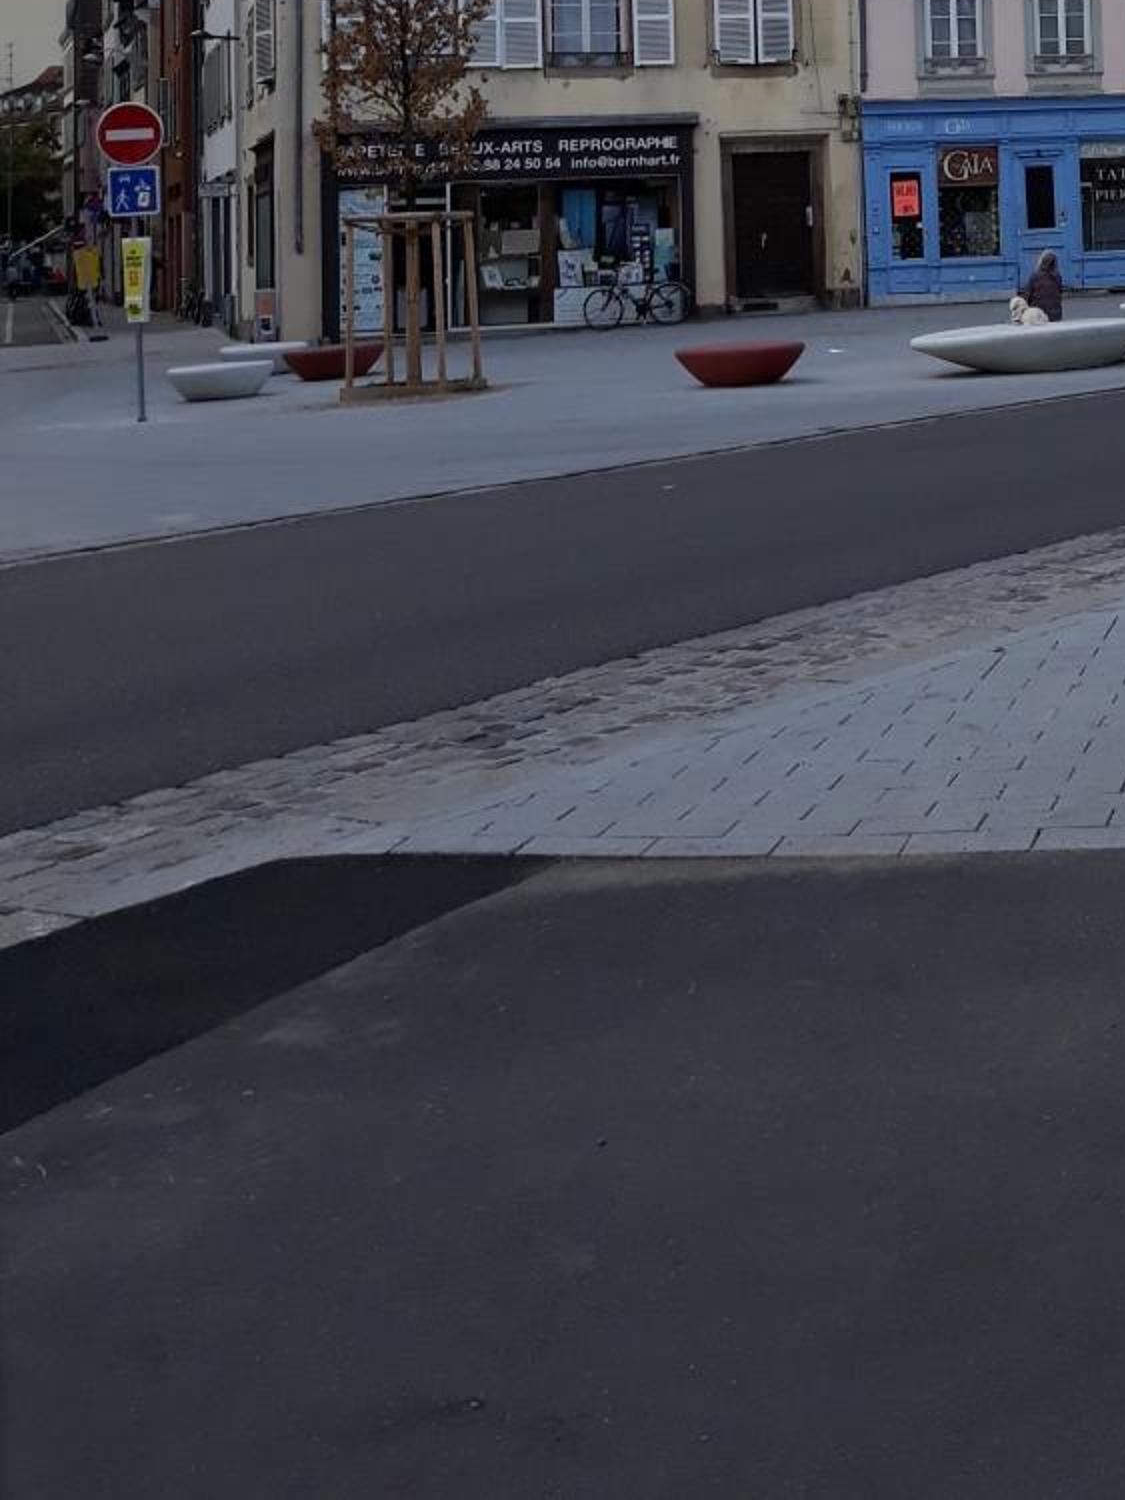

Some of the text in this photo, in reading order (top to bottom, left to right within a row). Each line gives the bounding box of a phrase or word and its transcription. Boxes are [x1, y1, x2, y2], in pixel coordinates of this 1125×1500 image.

[437, 140, 543, 157] BEUX-ARTS
[558, 136, 679, 153] REPROGRAPHIE
[502, 157, 521, 171] 24
[524, 157, 541, 170] 50
[545, 156, 561, 170] 54
[571, 153, 681, 169] info@bernhart.fr
